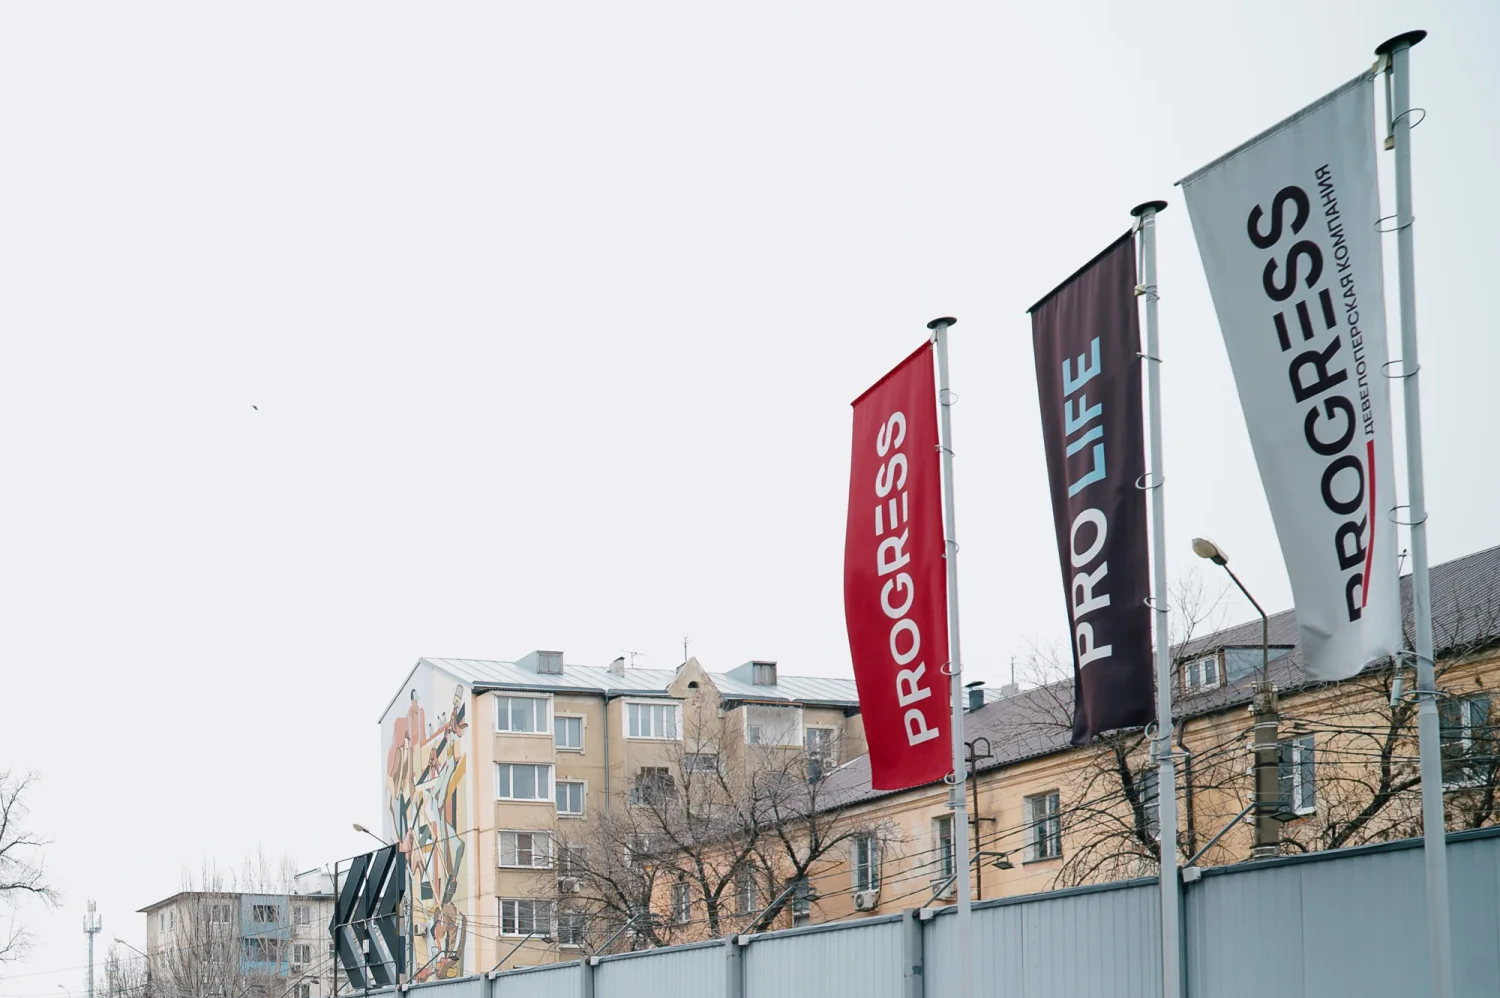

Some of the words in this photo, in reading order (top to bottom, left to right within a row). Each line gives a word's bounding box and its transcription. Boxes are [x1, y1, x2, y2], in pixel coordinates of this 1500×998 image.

[1315, 164, 1351, 273] КОМПАНИЯ
[1062, 336, 1107, 499] LIFE
[1247, 185, 1367, 622] PROGRESS
[1341, 272, 1374, 435] ДЕВЕЛОПЕРСКАЯ
[875, 411, 939, 747] PROGRESS
[1070, 508, 1112, 670] PRO
